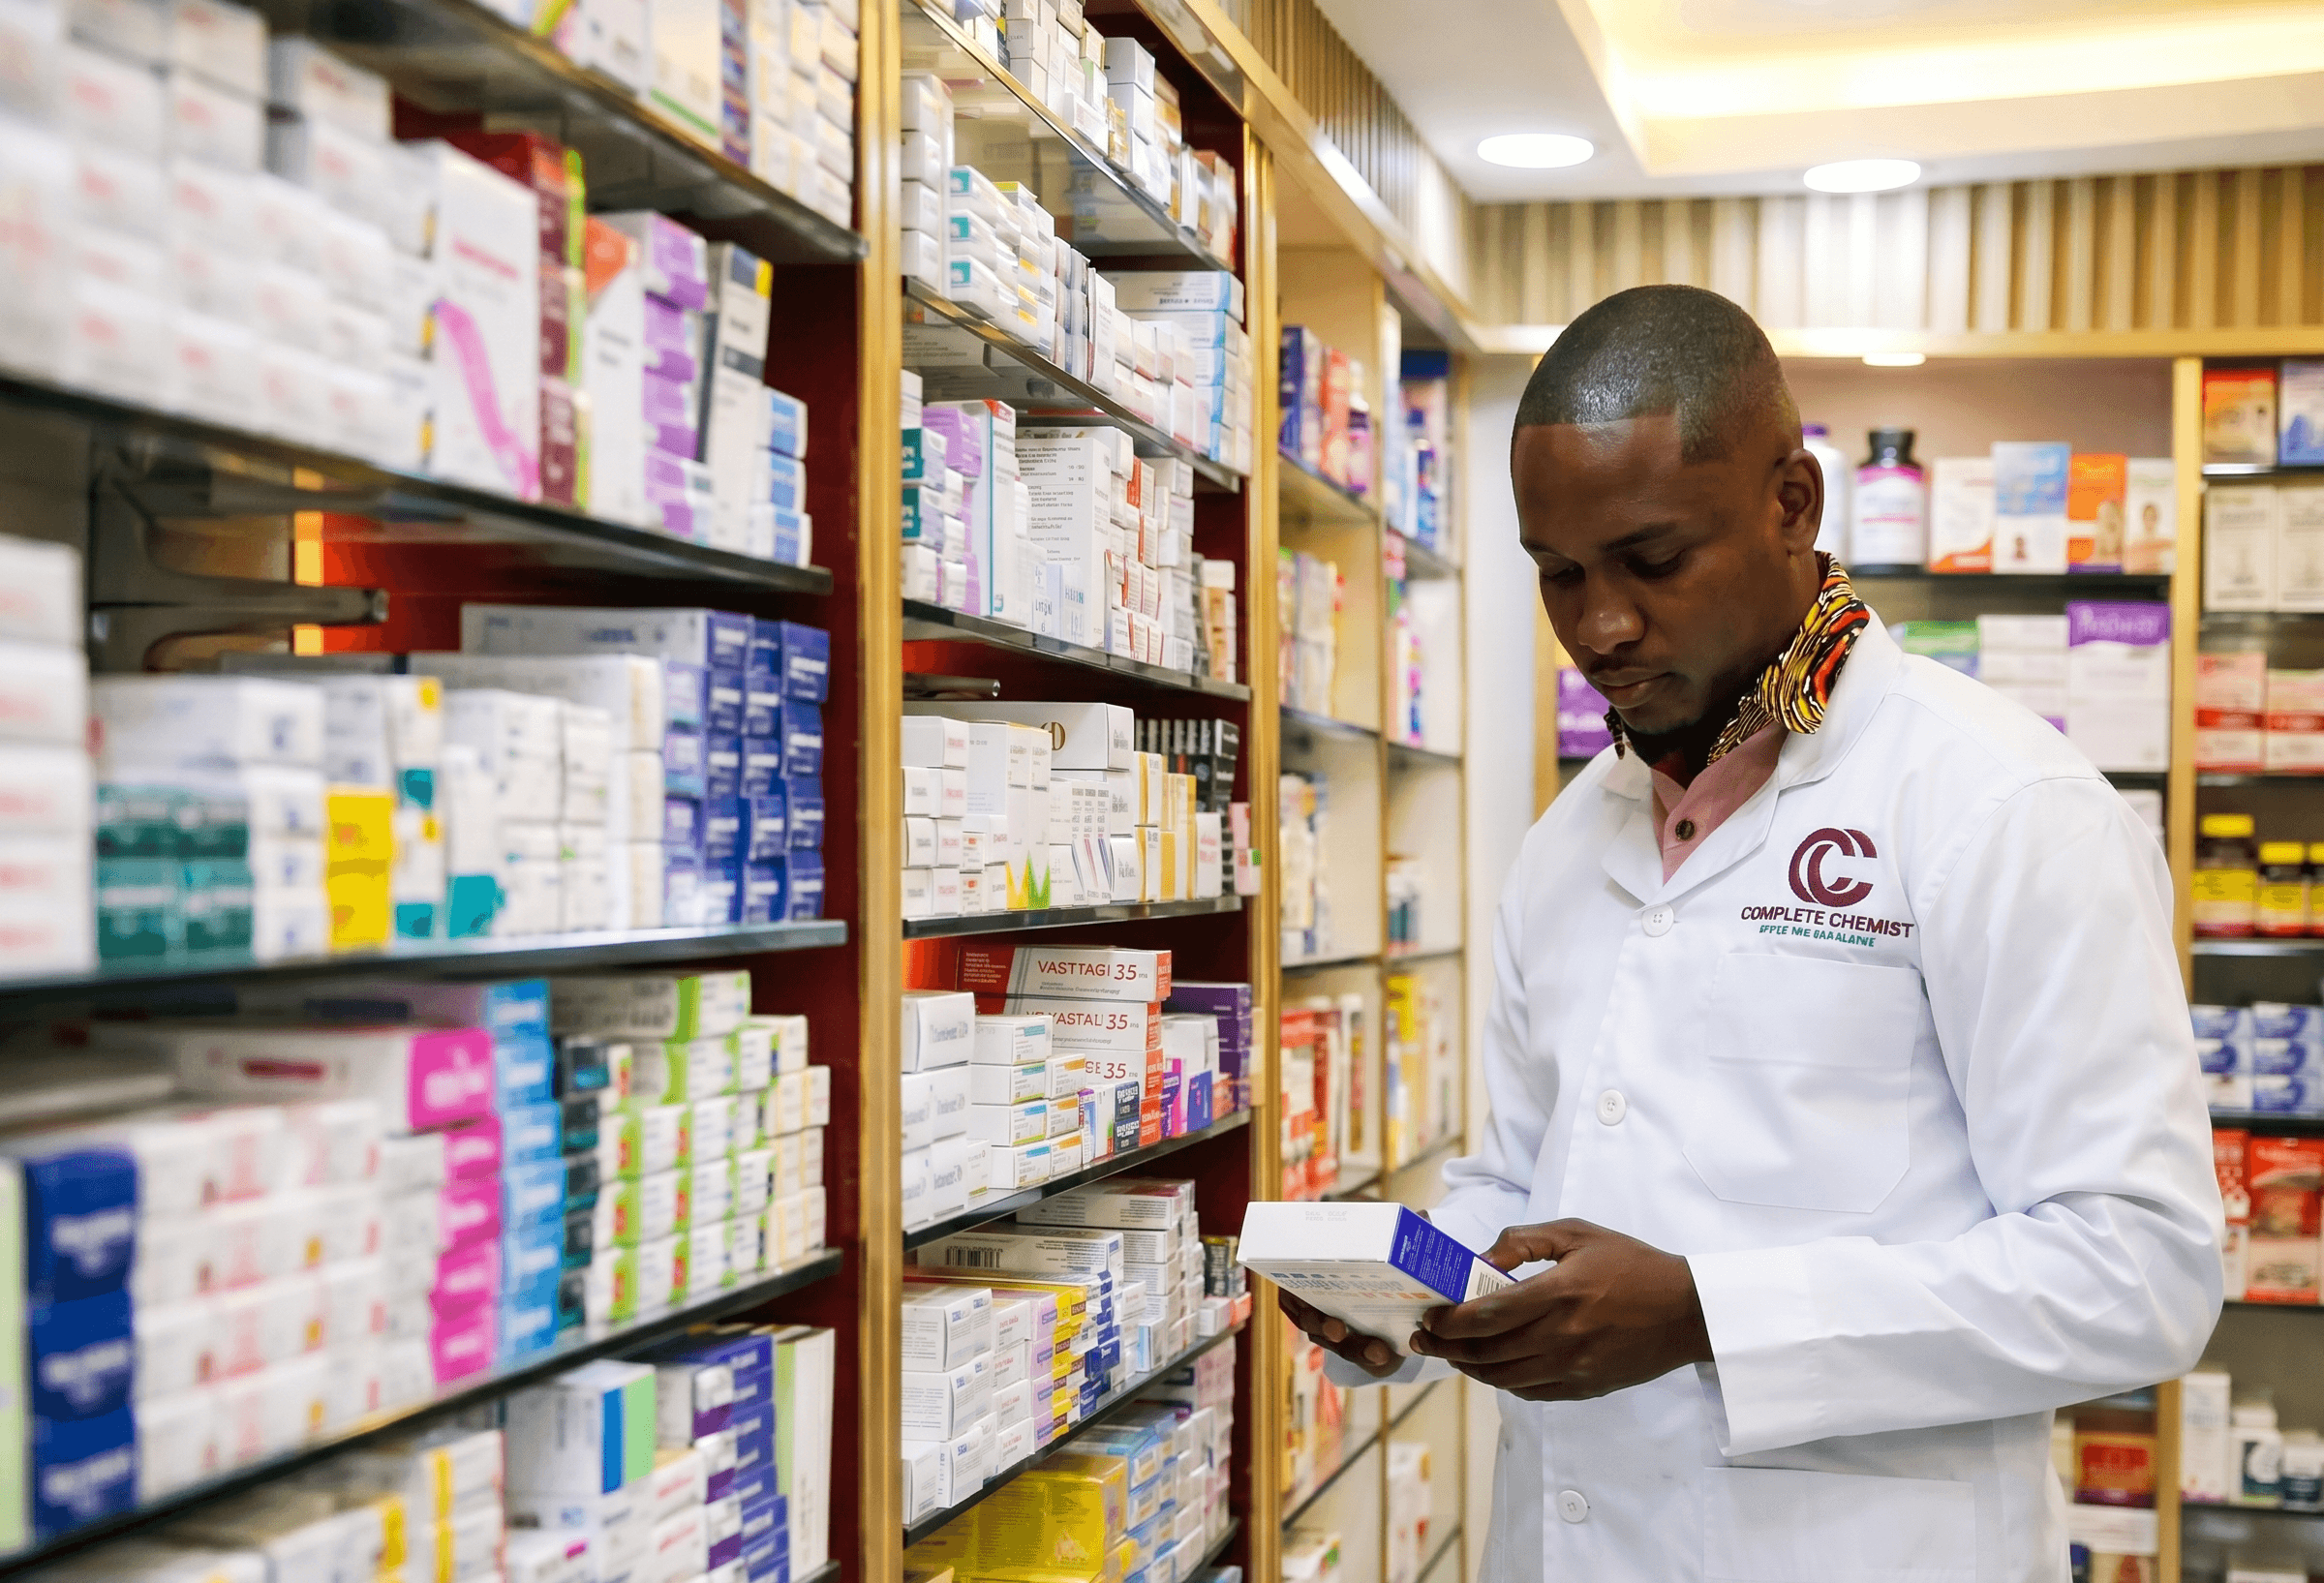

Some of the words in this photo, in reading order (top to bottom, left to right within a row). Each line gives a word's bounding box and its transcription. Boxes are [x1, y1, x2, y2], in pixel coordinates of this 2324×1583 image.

[1741, 906, 1825, 926] COMPLETE
[1828, 912, 1914, 938] CHEMIST
[1113, 963, 1138, 981] 35
[1106, 1013, 1129, 1030] 35
[1103, 1062, 1127, 1080] 35
